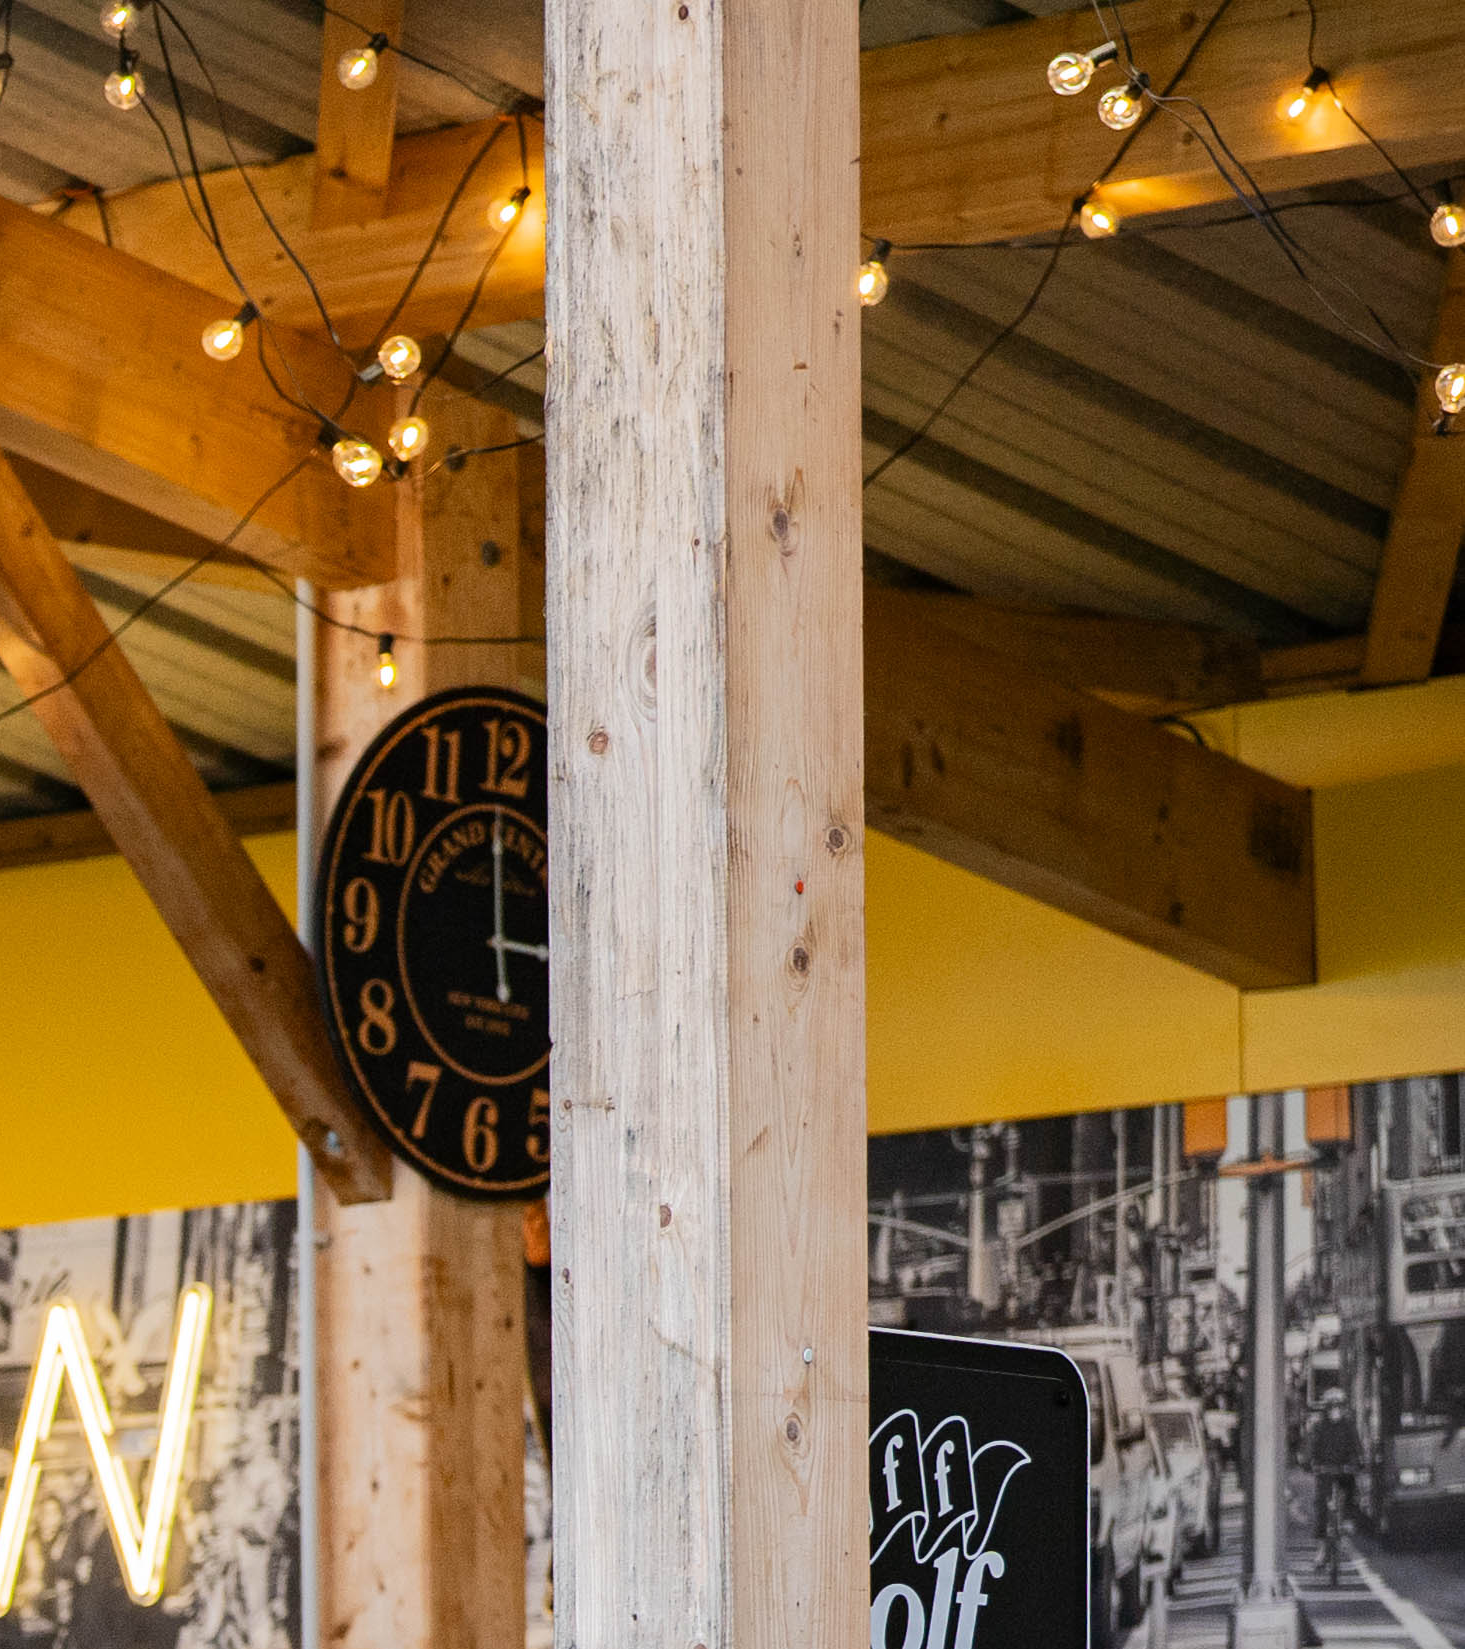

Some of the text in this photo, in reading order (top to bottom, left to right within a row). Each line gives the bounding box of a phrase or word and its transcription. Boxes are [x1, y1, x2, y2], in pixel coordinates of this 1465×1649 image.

[420, 724, 463, 805] 11
[479, 719, 532, 799] 12
[361, 788, 415, 866] 10
[343, 876, 380, 954] 9
[358, 978, 397, 1056] 8
[405, 1060, 441, 1140] 7
[462, 1096, 500, 1173] 6
